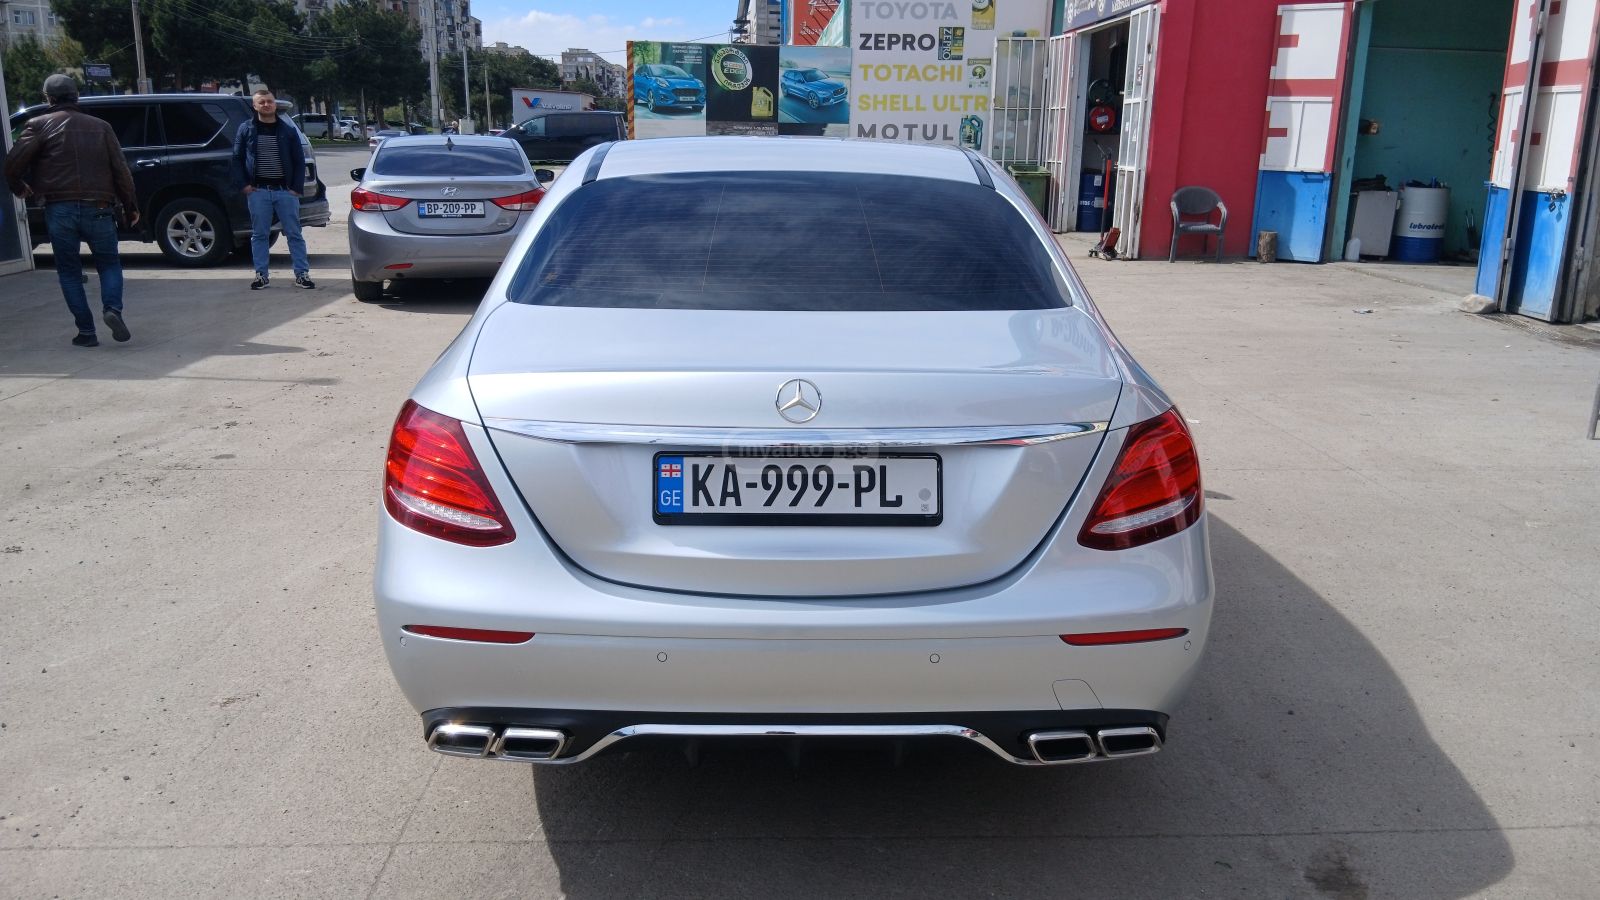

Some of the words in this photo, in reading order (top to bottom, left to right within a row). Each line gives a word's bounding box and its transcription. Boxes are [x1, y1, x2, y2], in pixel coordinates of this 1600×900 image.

[861, 2, 959, 20] TOYOTA
[859, 33, 936, 51] ZEPRO
[942, 27, 952, 60] ZEPRO
[859, 64, 963, 82] TOTACHI
[858, 94, 927, 112] SHELL
[857, 123, 954, 141] MOTUL
[426, 203, 477, 214] BP-209-PP
[691, 463, 903, 508] KA-999-PL
[660, 490, 681, 506] GE
